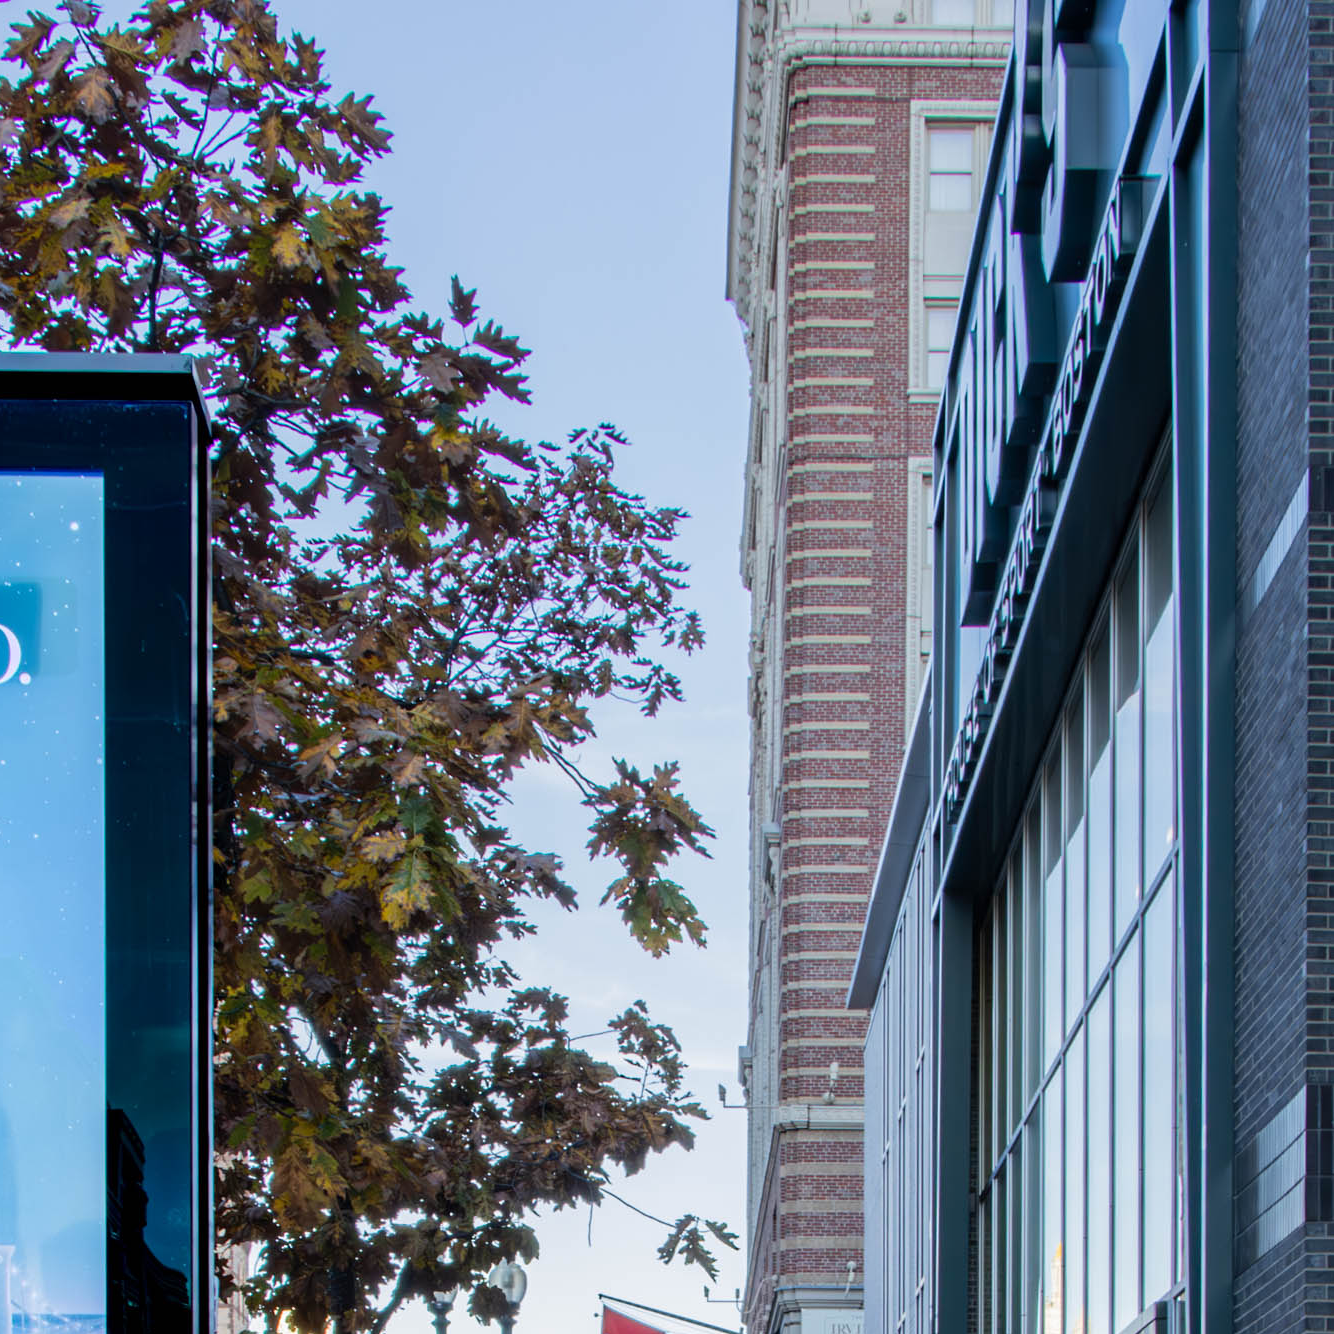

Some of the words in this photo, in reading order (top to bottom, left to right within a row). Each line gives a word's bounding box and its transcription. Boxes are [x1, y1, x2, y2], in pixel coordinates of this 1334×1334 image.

[946, 676, 980, 826] HOUSE
[982, 615, 998, 705] OF
[1001, 454, 1043, 649] SPORT
[1052, 178, 1121, 478] BOSTON
